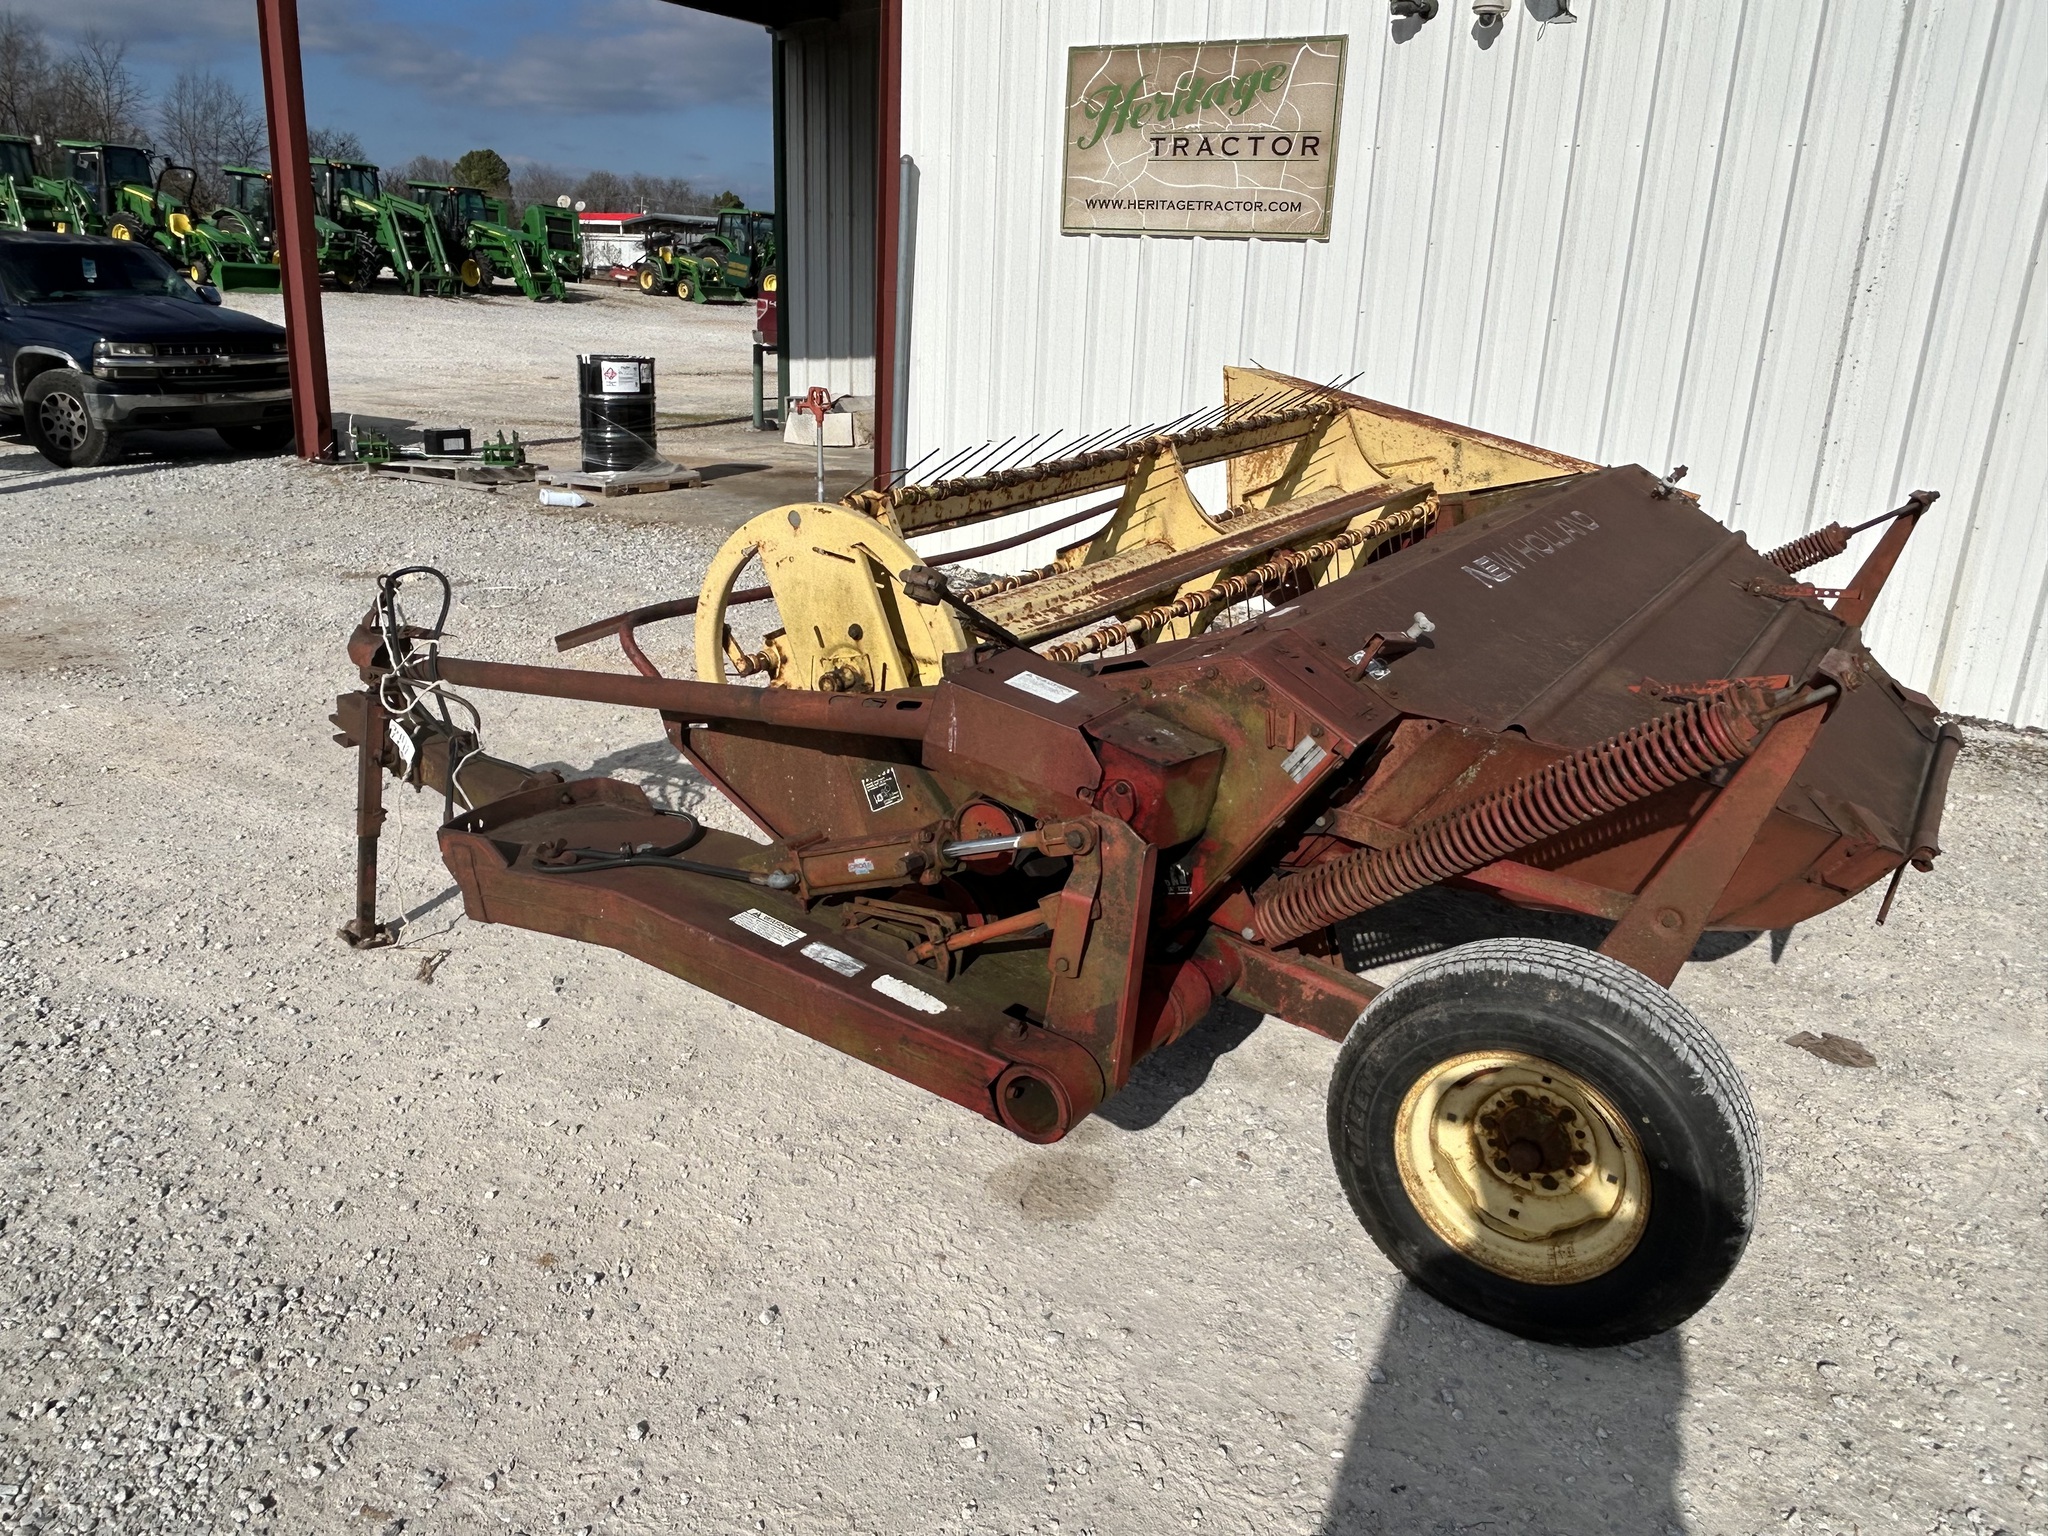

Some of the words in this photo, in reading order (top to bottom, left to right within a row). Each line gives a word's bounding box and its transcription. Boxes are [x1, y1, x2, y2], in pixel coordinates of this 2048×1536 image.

[1077, 63, 1288, 150] Heritage
[1150, 135, 1320, 157] TRACTOR
[1085, 198, 1302, 213] WWW.HERITAGETRACTOR.COM
[1460, 547, 1526, 589] NEW
[1508, 510, 1600, 563] HOLLAND
